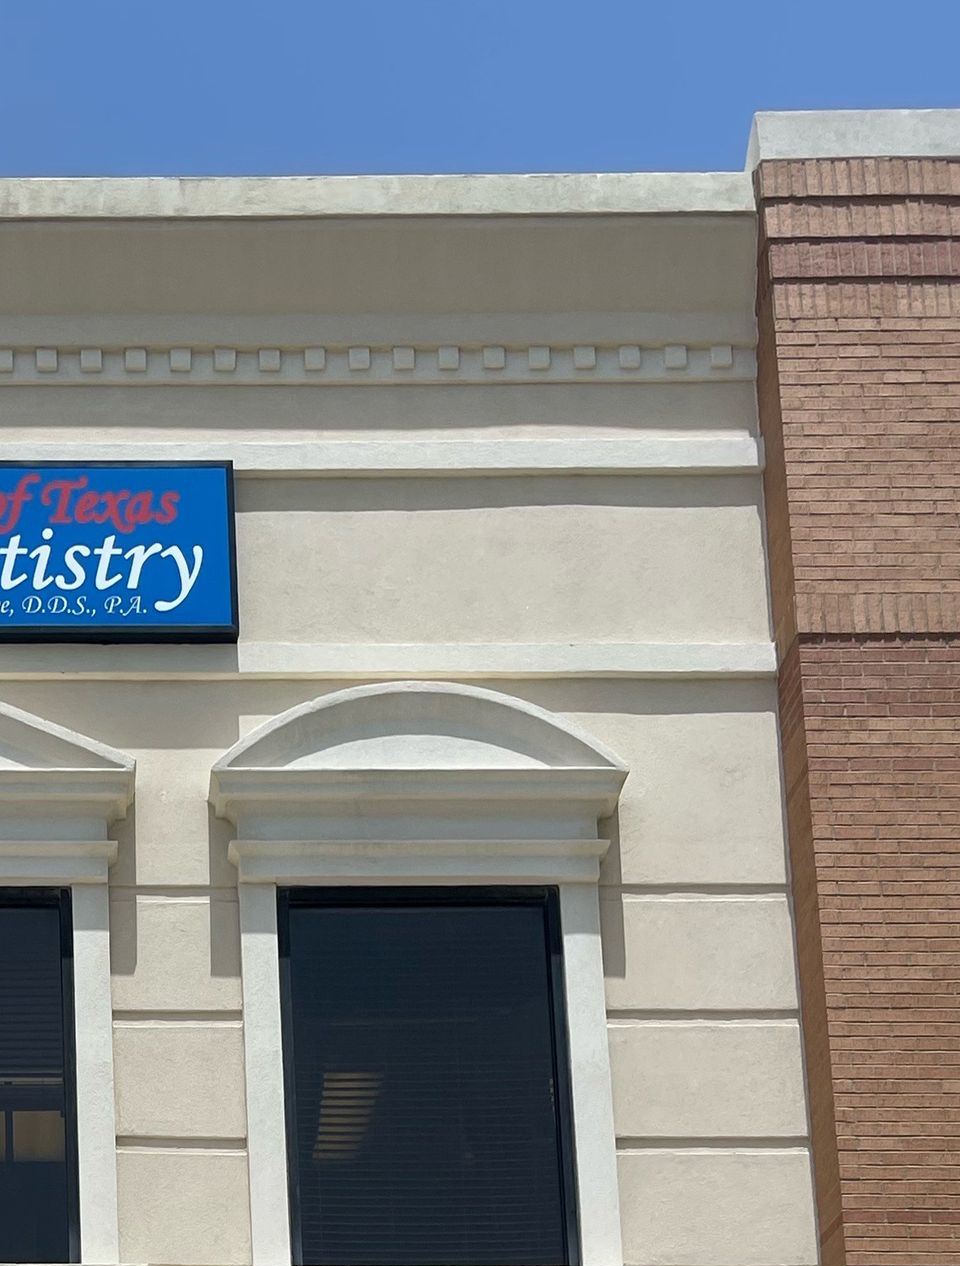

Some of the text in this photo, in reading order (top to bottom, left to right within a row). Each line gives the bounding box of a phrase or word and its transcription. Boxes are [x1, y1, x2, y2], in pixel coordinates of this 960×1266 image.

[41, 475, 181, 534] Texas
[21, 595, 97, 617] D.D.S.,
[103, 595, 148, 617] P.A.
